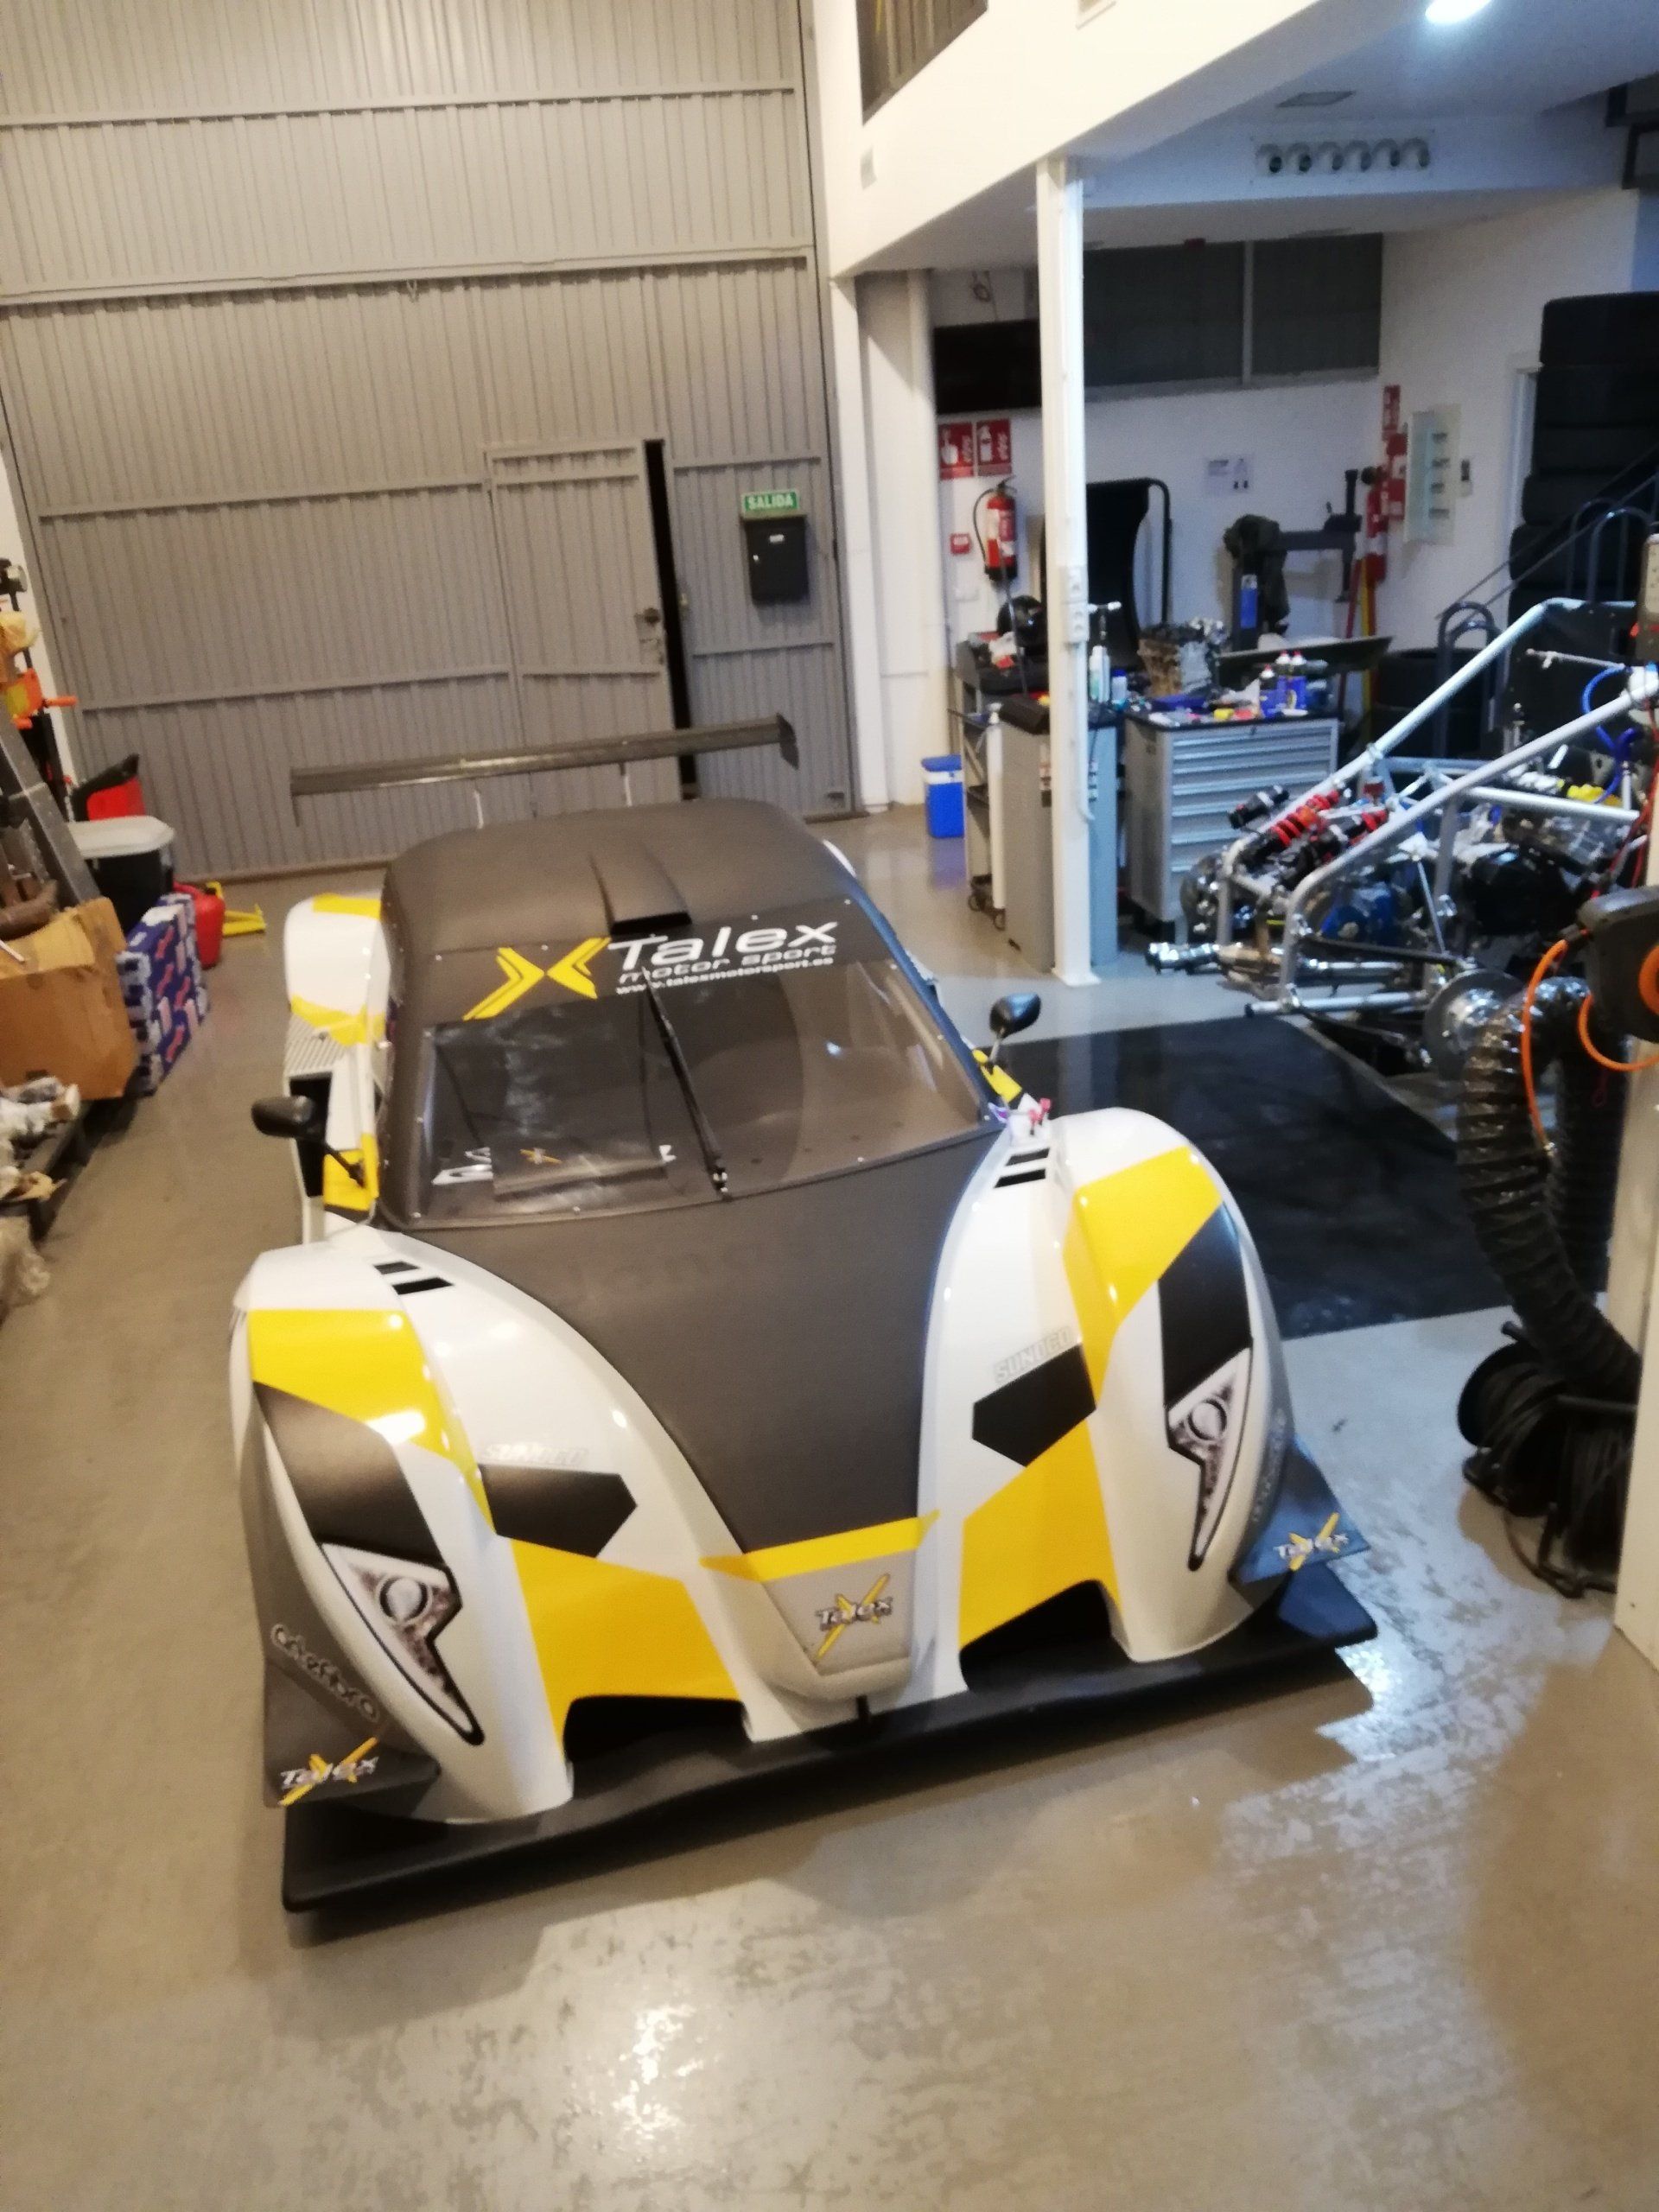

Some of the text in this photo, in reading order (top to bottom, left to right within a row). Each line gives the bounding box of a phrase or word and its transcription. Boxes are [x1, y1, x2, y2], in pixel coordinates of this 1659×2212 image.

[747, 492, 793, 510] SALIDA
[607, 921, 838, 970] Talex
[620, 944, 836, 984] motor sport
